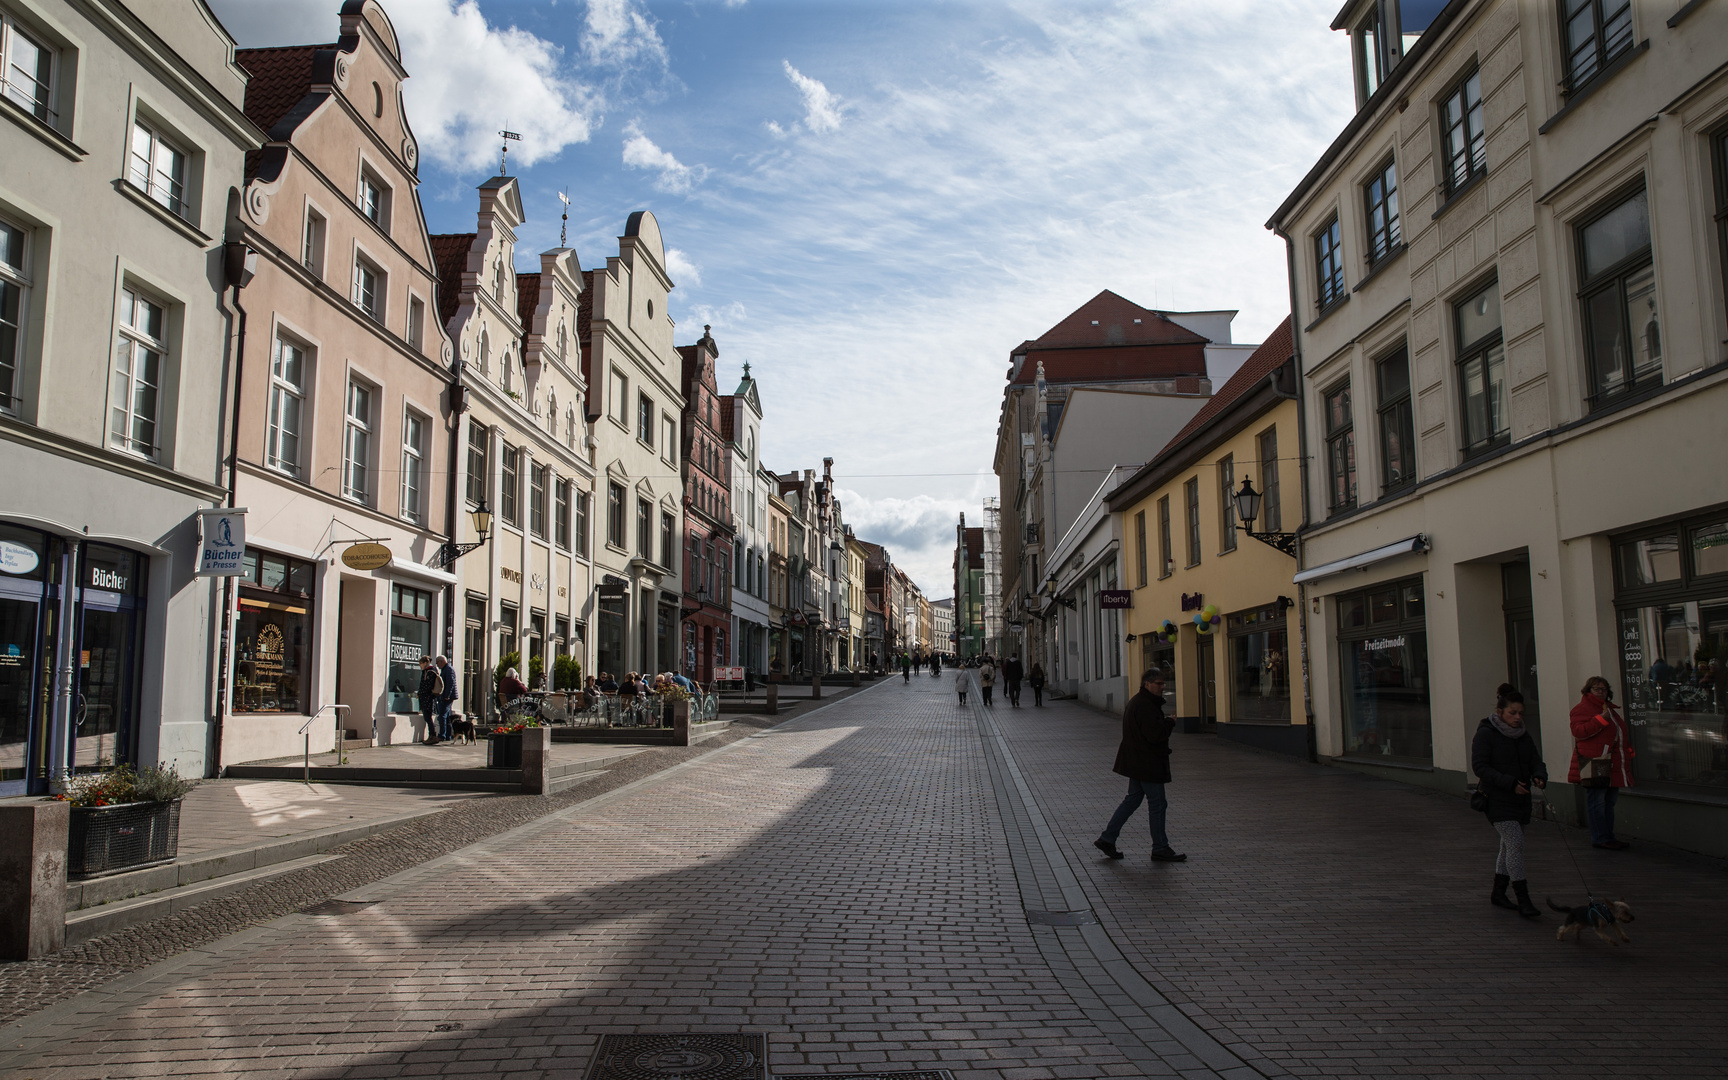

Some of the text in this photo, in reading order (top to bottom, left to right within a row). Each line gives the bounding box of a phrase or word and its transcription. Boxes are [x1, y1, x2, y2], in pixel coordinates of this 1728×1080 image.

[204, 549, 242, 560] Bücher
[344, 553, 389, 561] TOBACCOHOUSE
[213, 561, 237, 569] Presse
[92, 567, 128, 590] Bücher
[1103, 594, 1129, 604] liberty
[256, 623, 285, 653] TOBACCOHOUSE
[1364, 635, 1405, 651] Freizeitmode
[391, 644, 422, 661] FISCHLEDER
[1626, 674, 1644, 686] högl
[499, 696, 542, 713] CONDITOREI
[586, 696, 648, 715] CONDITOREI CAFE
